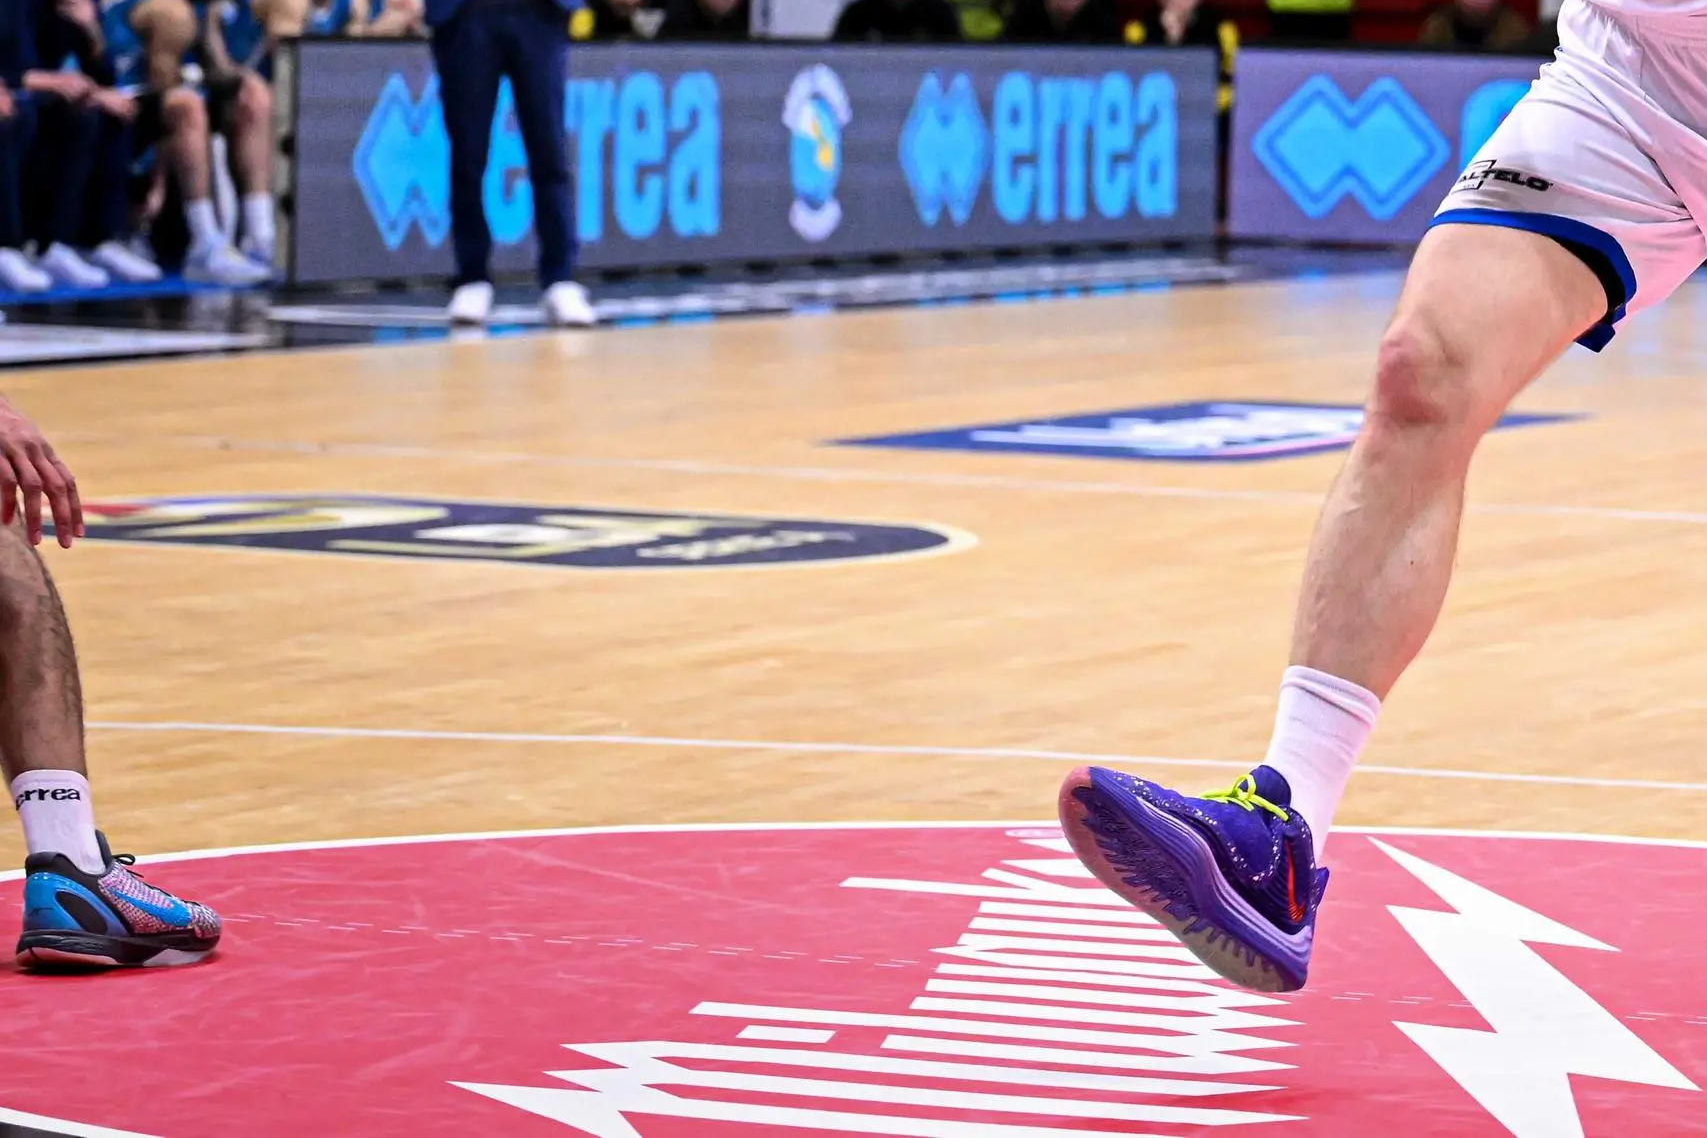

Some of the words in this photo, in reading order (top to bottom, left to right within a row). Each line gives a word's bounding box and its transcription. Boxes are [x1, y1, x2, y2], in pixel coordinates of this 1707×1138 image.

[481, 70, 721, 246] erea
[993, 70, 1178, 223] errea
[15, 788, 81, 811] errea
[445, 833, 1310, 1138] Milwauk
